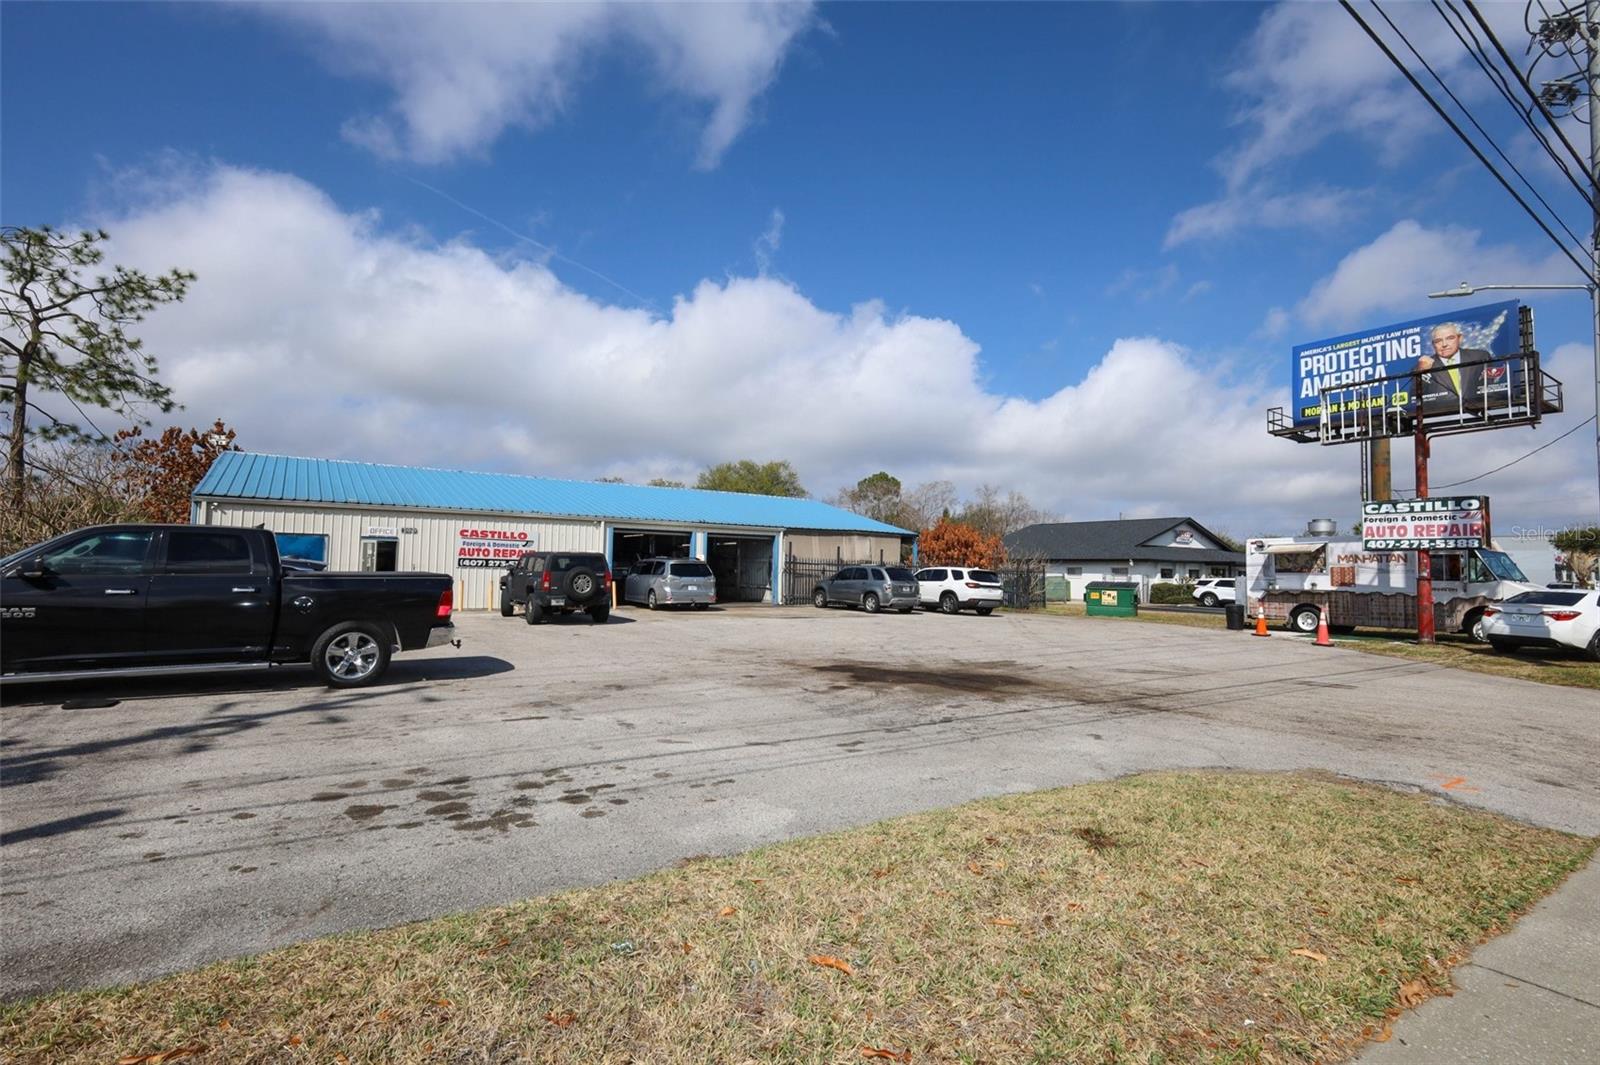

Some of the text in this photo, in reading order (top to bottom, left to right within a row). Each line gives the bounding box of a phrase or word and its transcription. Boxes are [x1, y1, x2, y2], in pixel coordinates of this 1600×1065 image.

[1333, 339, 1361, 350] LARGEST
[1361, 334, 1385, 345] INJURY
[1386, 330, 1402, 339] LAW
[1402, 326, 1420, 336] FIRM
[1300, 335, 1421, 378] PROTECTING
[1300, 364, 1388, 399] AMERICA
[1365, 499, 1480, 513] CASTILLO
[1411, 513, 1457, 521] Domestic
[369, 527, 395, 535] OFFICE
[459, 529, 528, 540] CASTILLO
[1364, 522, 1482, 538] AUTO REPAIR
[1366, 538, 1480, 549] 407-273-5388
[458, 547, 491, 557] AUTO
[459, 559, 486, 567] (407)
[1337, 553, 1408, 564] MANHATTAN
